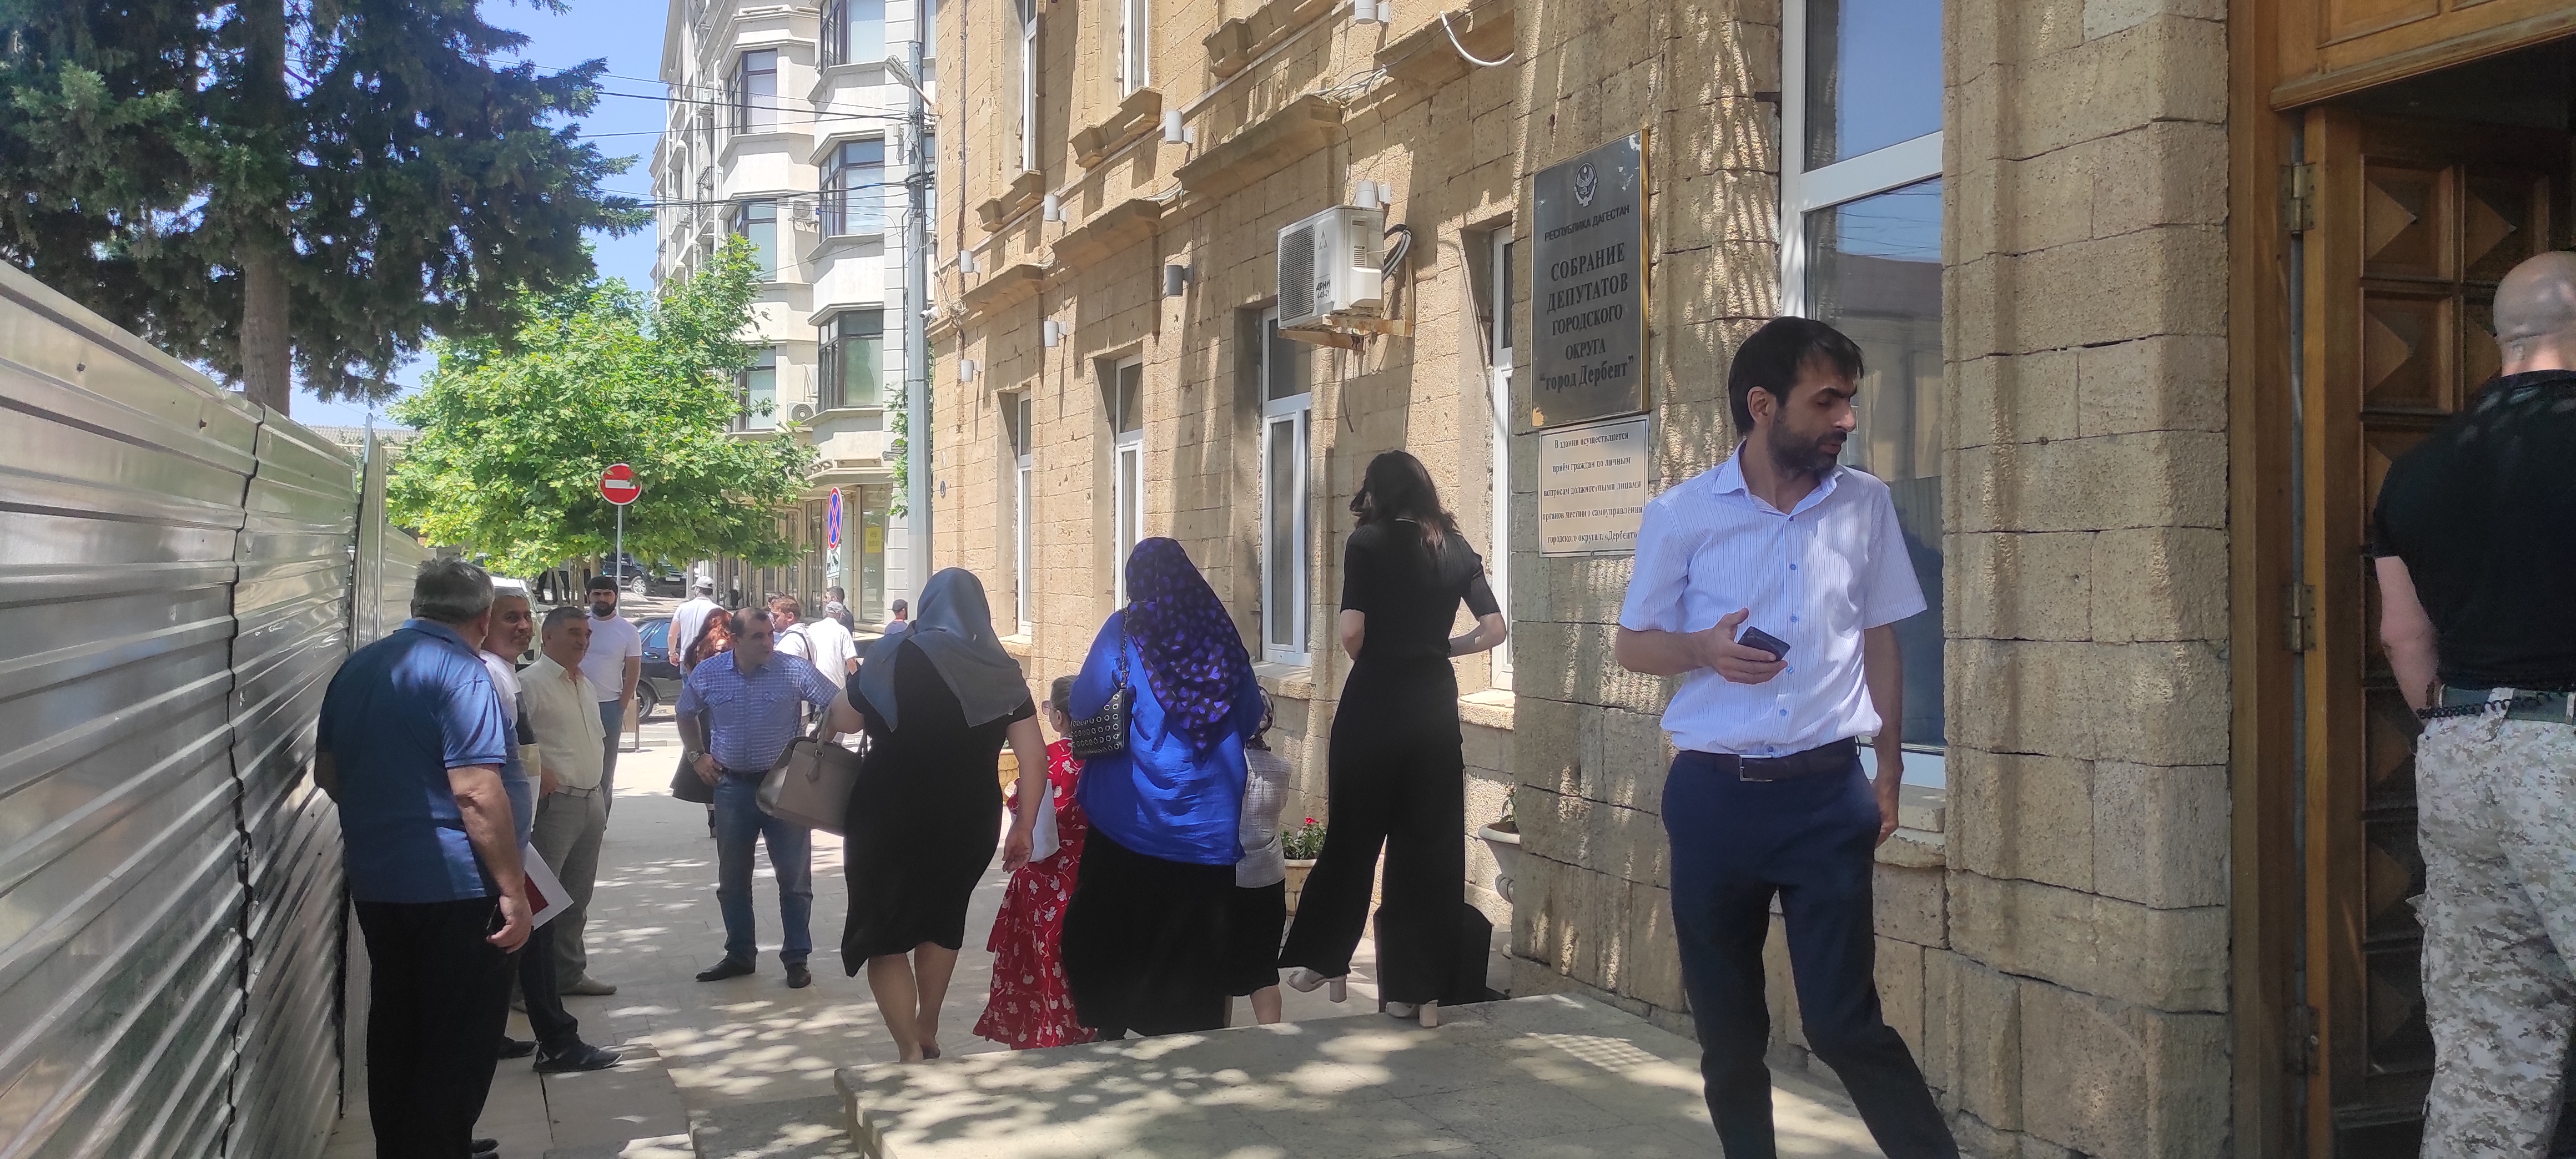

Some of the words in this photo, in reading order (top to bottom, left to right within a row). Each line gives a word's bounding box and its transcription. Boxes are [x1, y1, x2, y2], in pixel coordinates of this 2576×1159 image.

[1544, 219, 1591, 241] РЕСПУБЛИКА
[1592, 204, 1629, 228] ДАГЕСТАН
[1551, 243, 1625, 281] СОБРАНИЕ
[1547, 273, 1628, 315] ДЕПУТАТОВ
[1552, 304, 1623, 336] ГОРОДСКОГО
[1566, 337, 1606, 360] ОКРУГА
[1555, 440, 1558, 449] В
[1560, 439, 1579, 449] здании
[1581, 432, 1628, 447] осуществляется
[1552, 463, 1569, 475] приём
[1571, 461, 1594, 472] граждан
[1605, 457, 1631, 466] личным
[1544, 487, 1569, 498] вопросам
[1571, 483, 1614, 495] должностными
[1617, 481, 1641, 490] лицами
[1543, 512, 1564, 522] органов
[1566, 510, 1590, 518] местного
[1592, 506, 1642, 518] самоуправления
[1548, 533, 1577, 545] городского
[1578, 532, 1598, 544] округа
